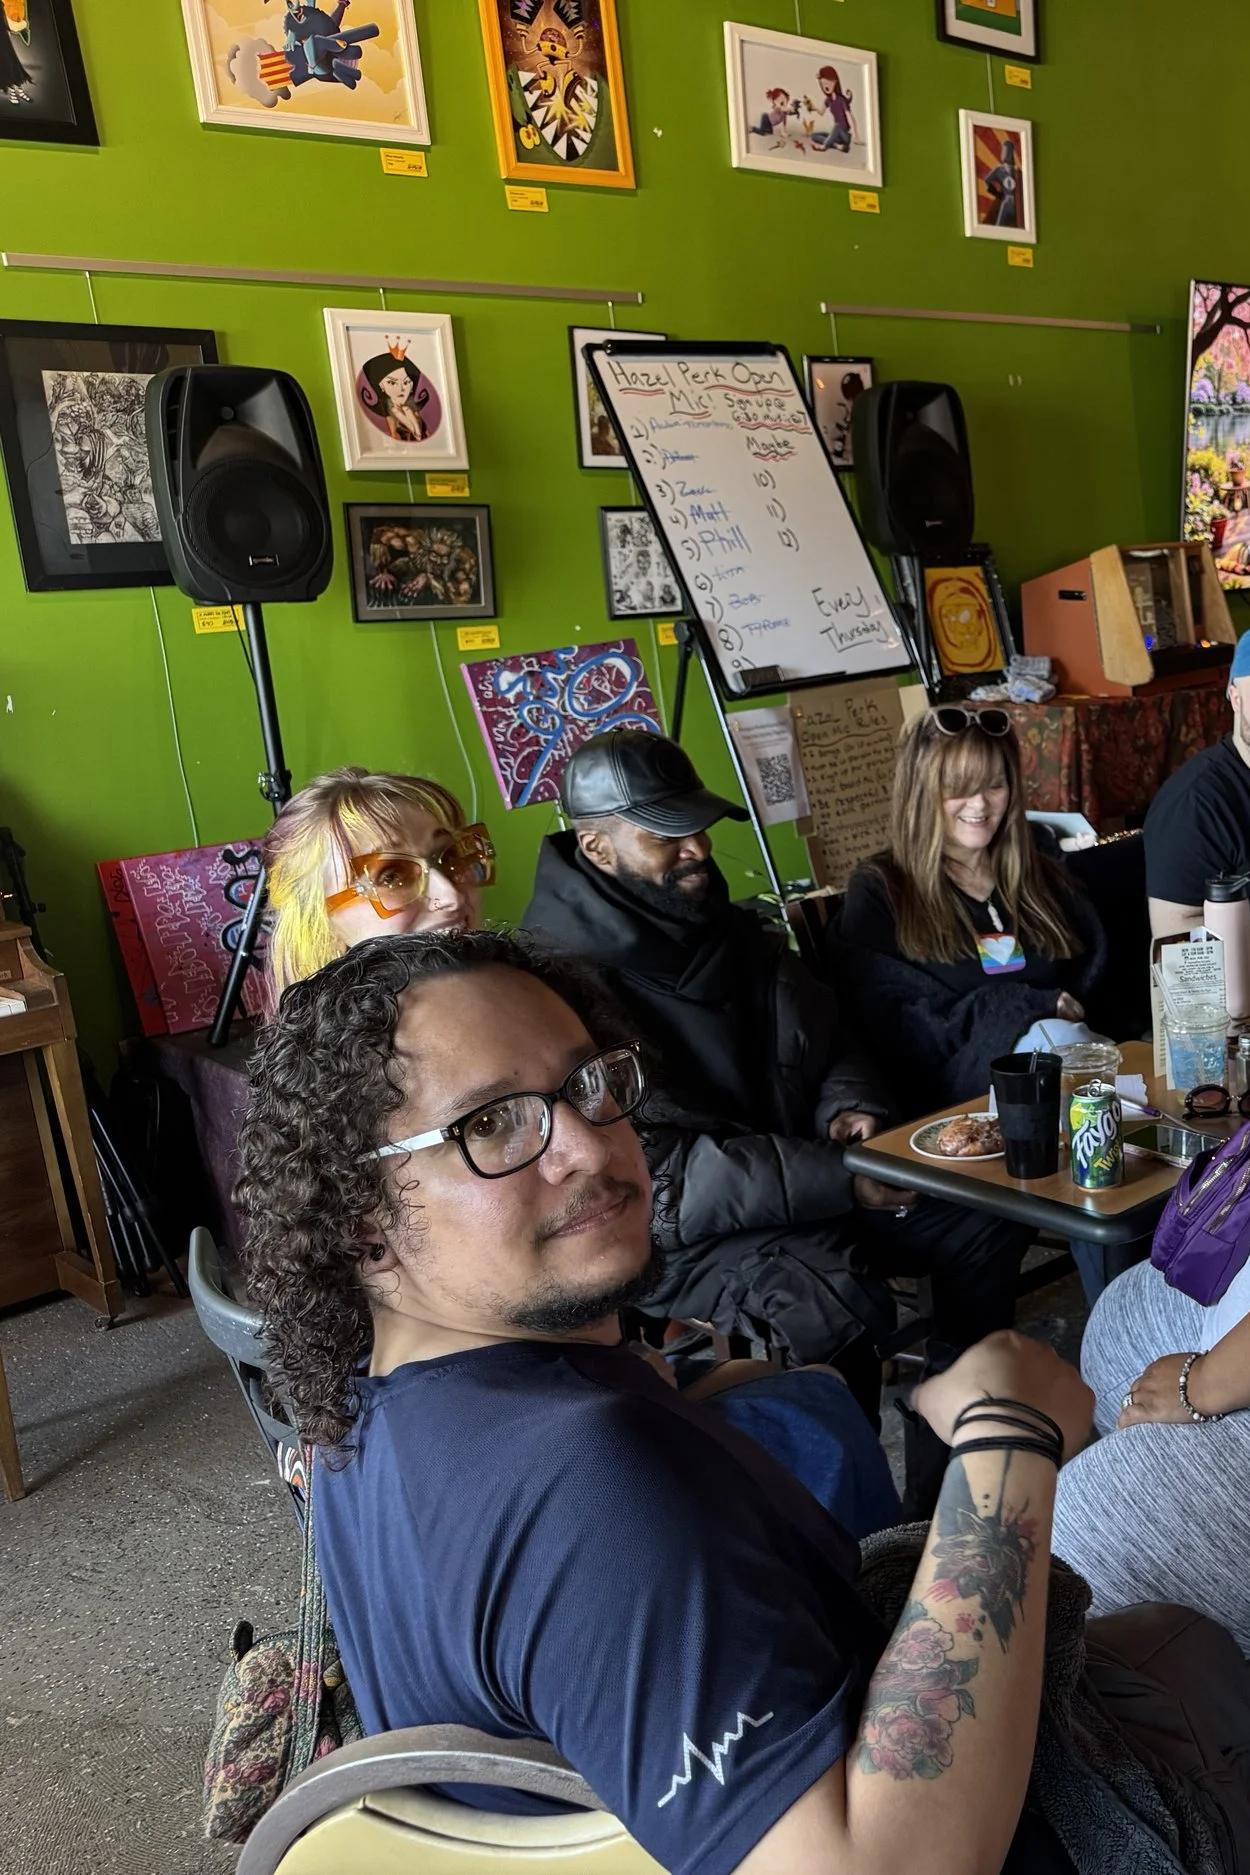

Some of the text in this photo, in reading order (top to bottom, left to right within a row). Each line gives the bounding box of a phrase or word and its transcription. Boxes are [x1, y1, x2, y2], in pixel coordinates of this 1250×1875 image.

[607, 361, 786, 391] Hazel Perk Open
[746, 435, 795, 451] Maybe
[753, 469, 776, 489] 10)
[689, 500, 731, 525] Matt
[766, 497, 786, 522] 11)
[699, 524, 752, 556] Phill
[778, 528, 800, 552] 12)
[820, 620, 889, 652] Thursday
[1179, 974, 1217, 982] Sandwiches
[1072, 1100, 1121, 1169] Faygo
